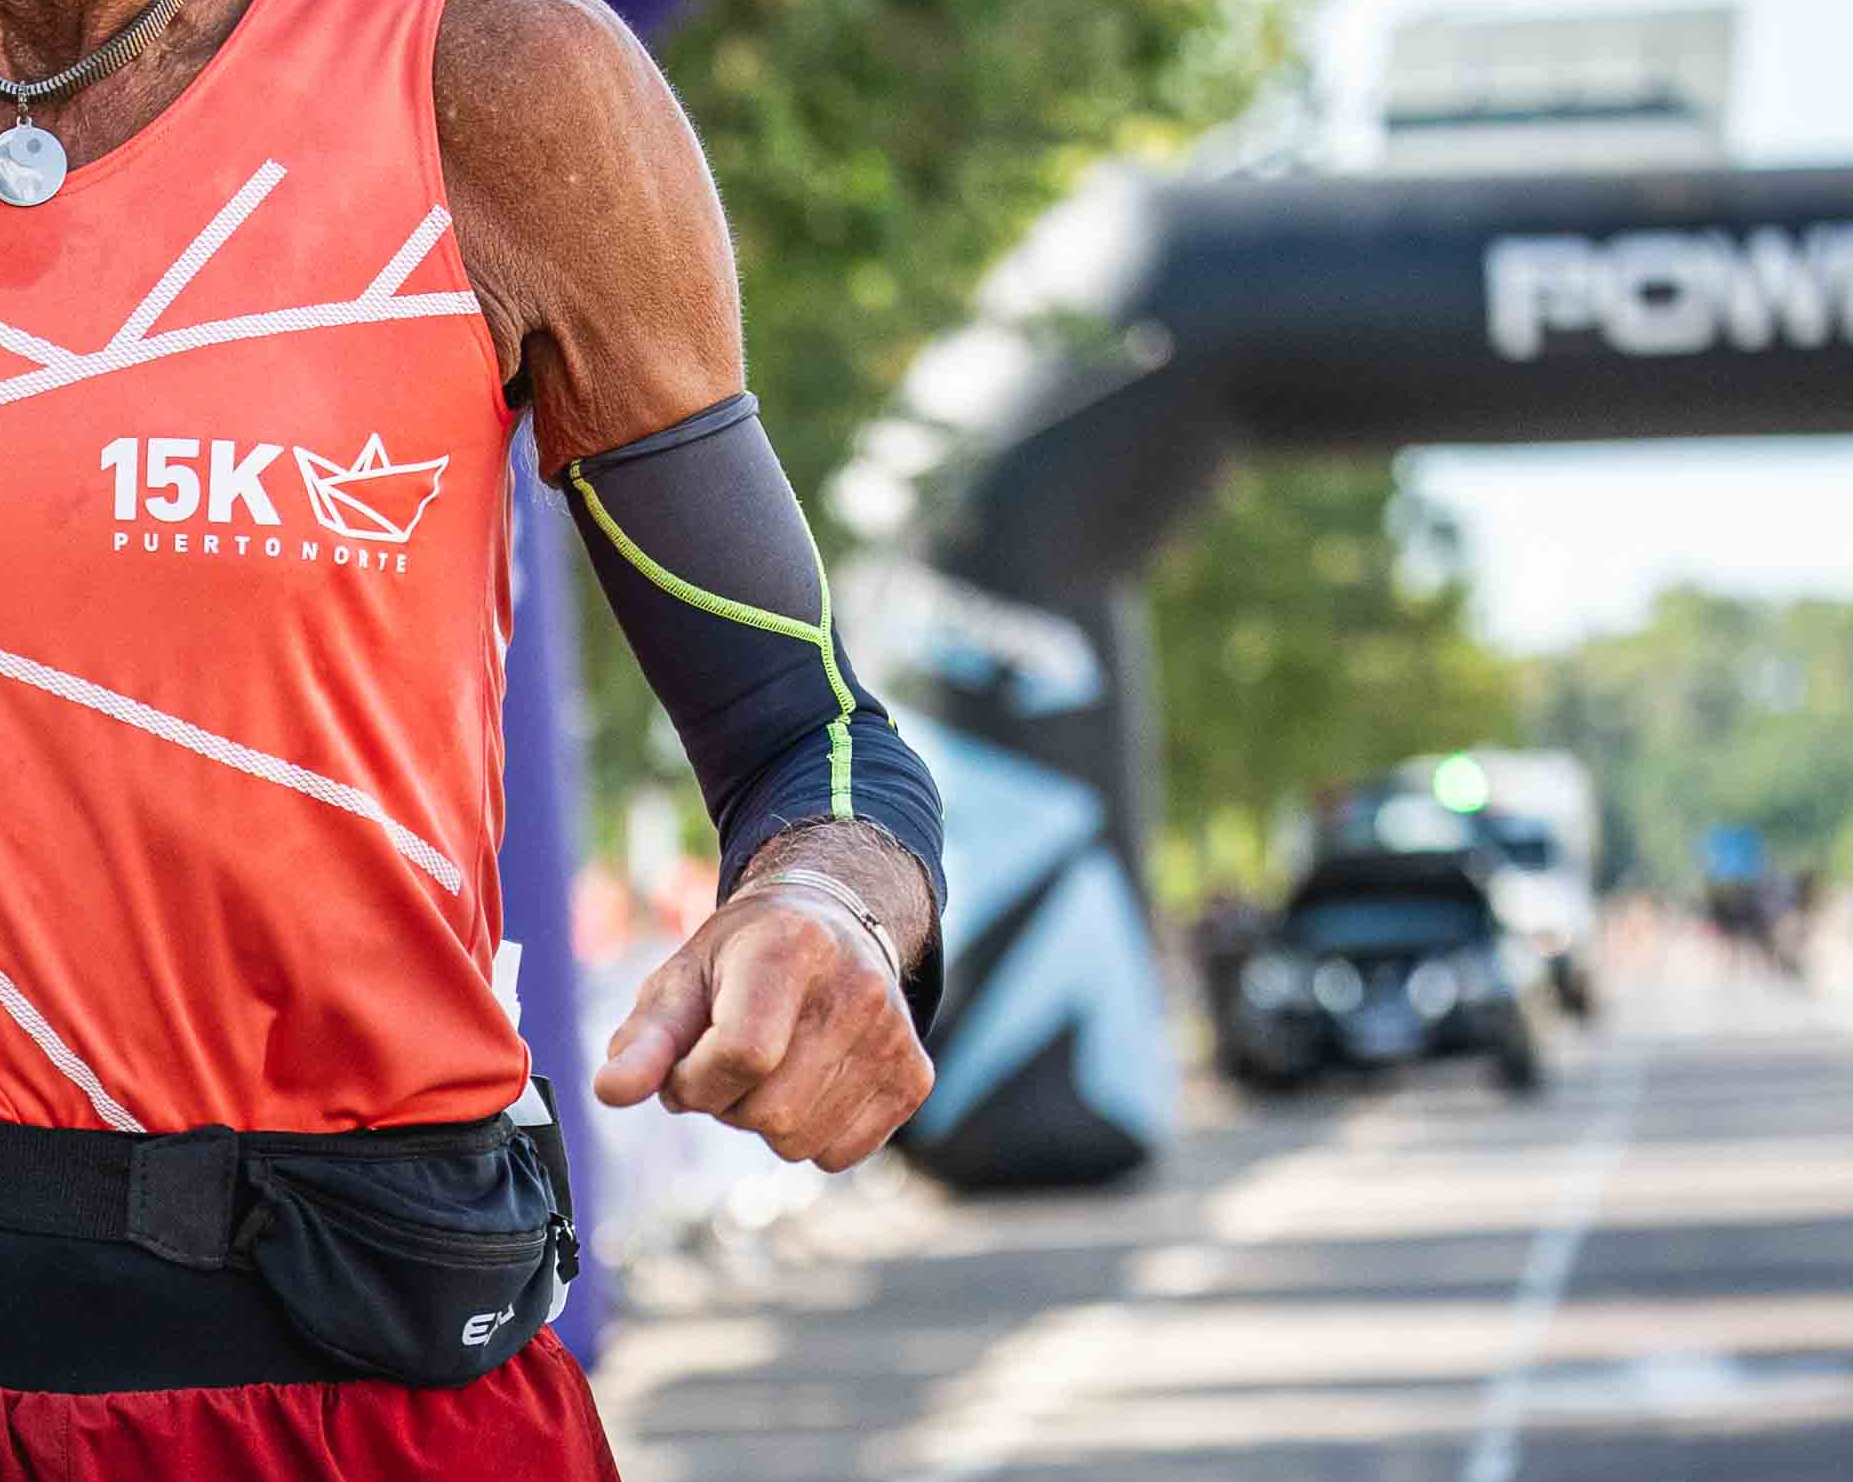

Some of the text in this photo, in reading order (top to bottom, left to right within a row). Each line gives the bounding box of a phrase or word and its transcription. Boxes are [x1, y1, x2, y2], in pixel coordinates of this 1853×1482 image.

[1482, 221, 1853, 361] POW
[100, 437, 285, 526] 15K
[113, 531, 408, 574] PUERTO NORTE
